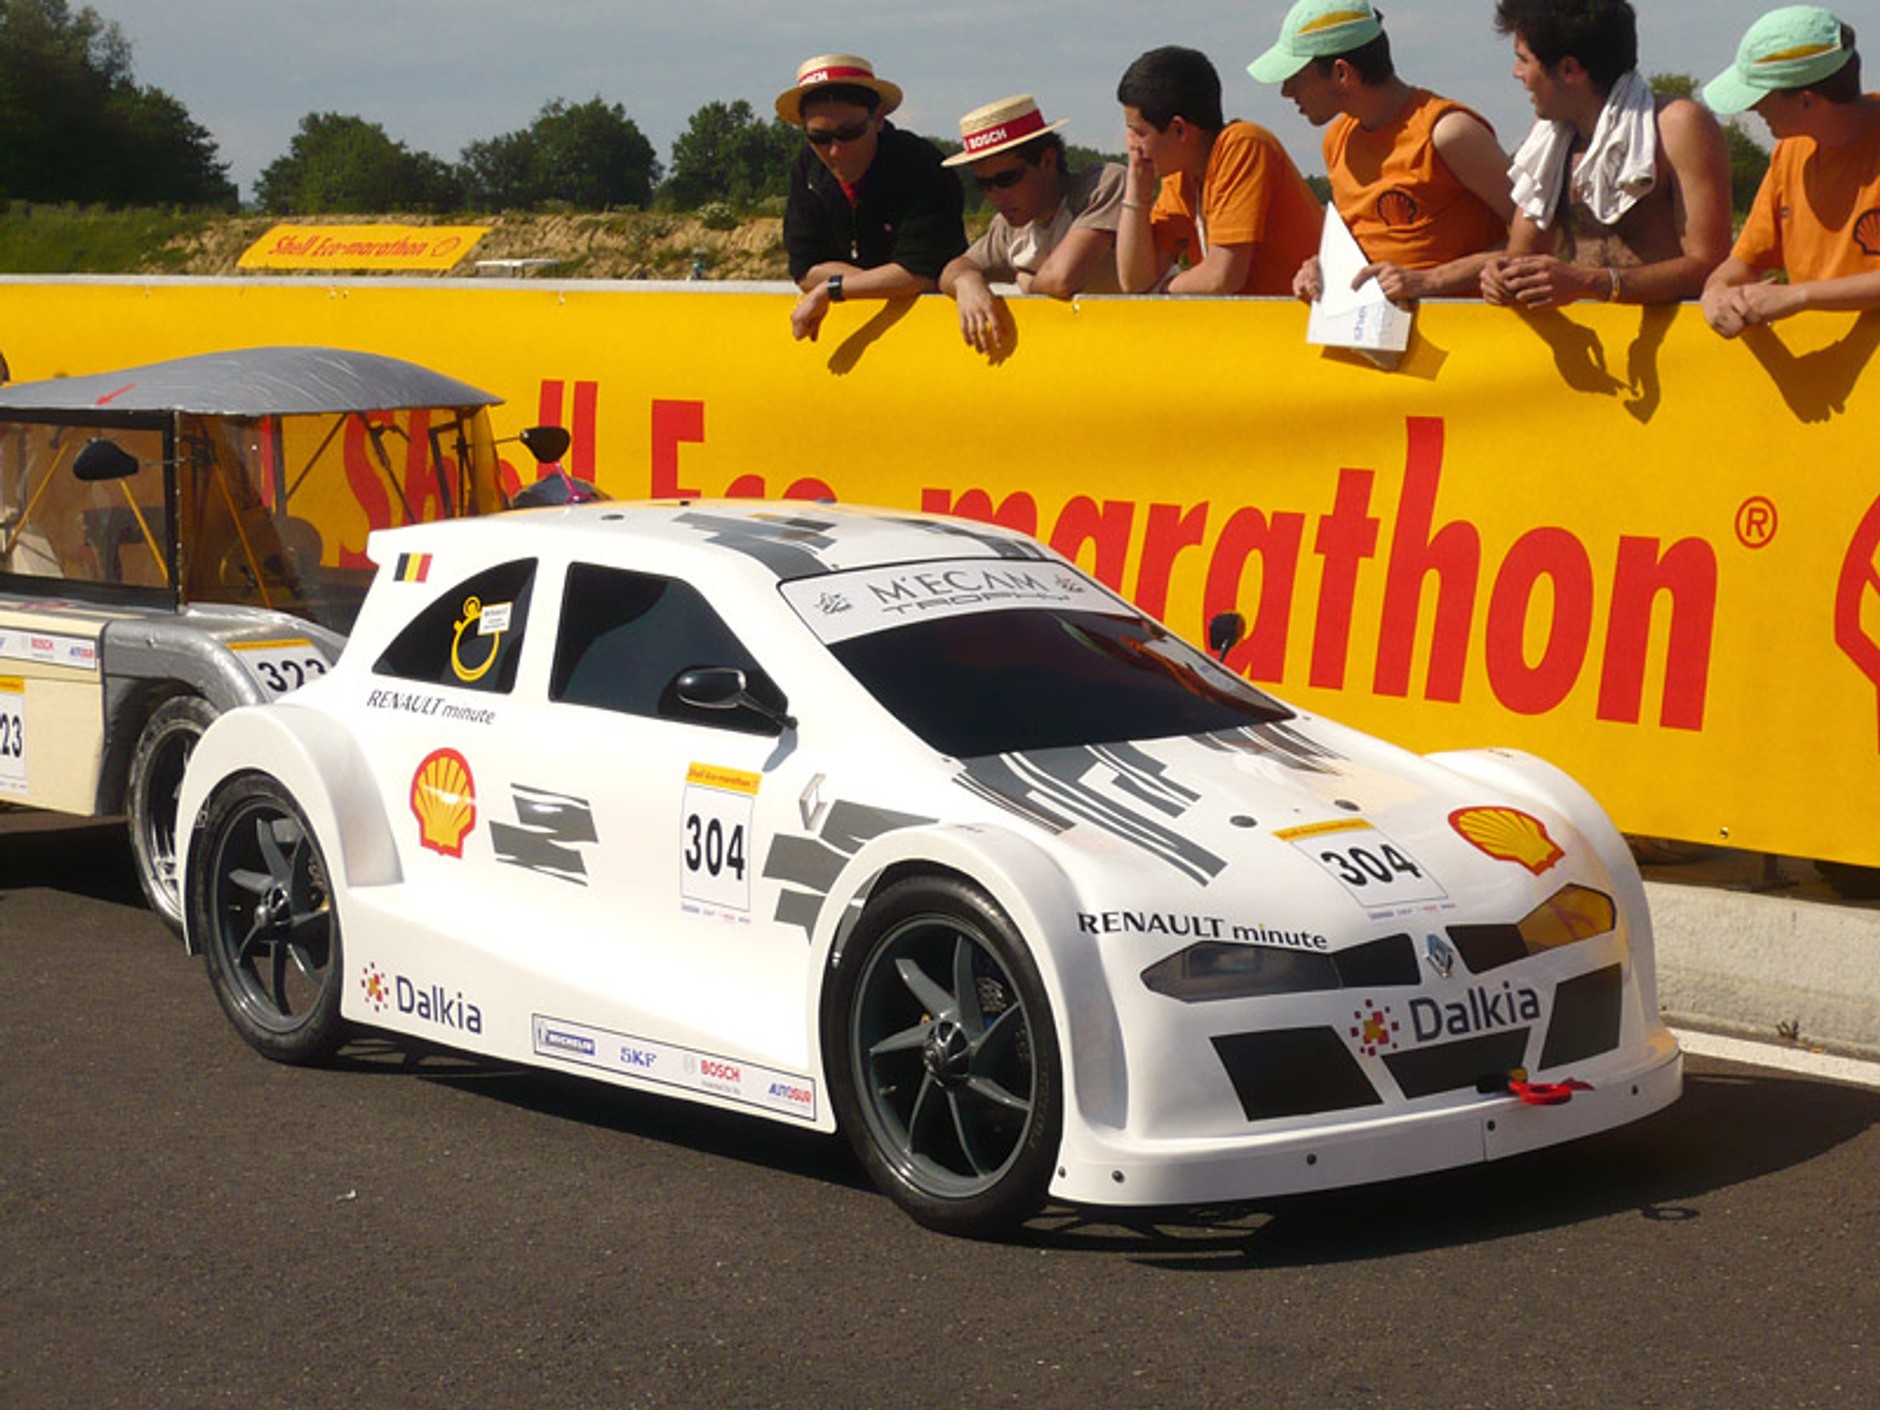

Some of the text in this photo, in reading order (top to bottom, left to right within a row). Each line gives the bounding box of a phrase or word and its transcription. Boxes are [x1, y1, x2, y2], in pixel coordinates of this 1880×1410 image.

[968, 127, 1008, 150] BOSCH
[268, 234, 428, 258] Shell Eco-marathon
[366, 689, 496, 725] RENAULT minute
[685, 813, 745, 880] 304
[1320, 844, 1422, 886] 304
[1077, 912, 1329, 949] RENAULT minute
[395, 975, 483, 1035] Dalkia
[1408, 980, 1540, 1043] Dalkia
[620, 1046, 657, 1067] SKF
[701, 1060, 740, 1081] BOSCH
[768, 1083, 812, 1103] AUTOSUR
